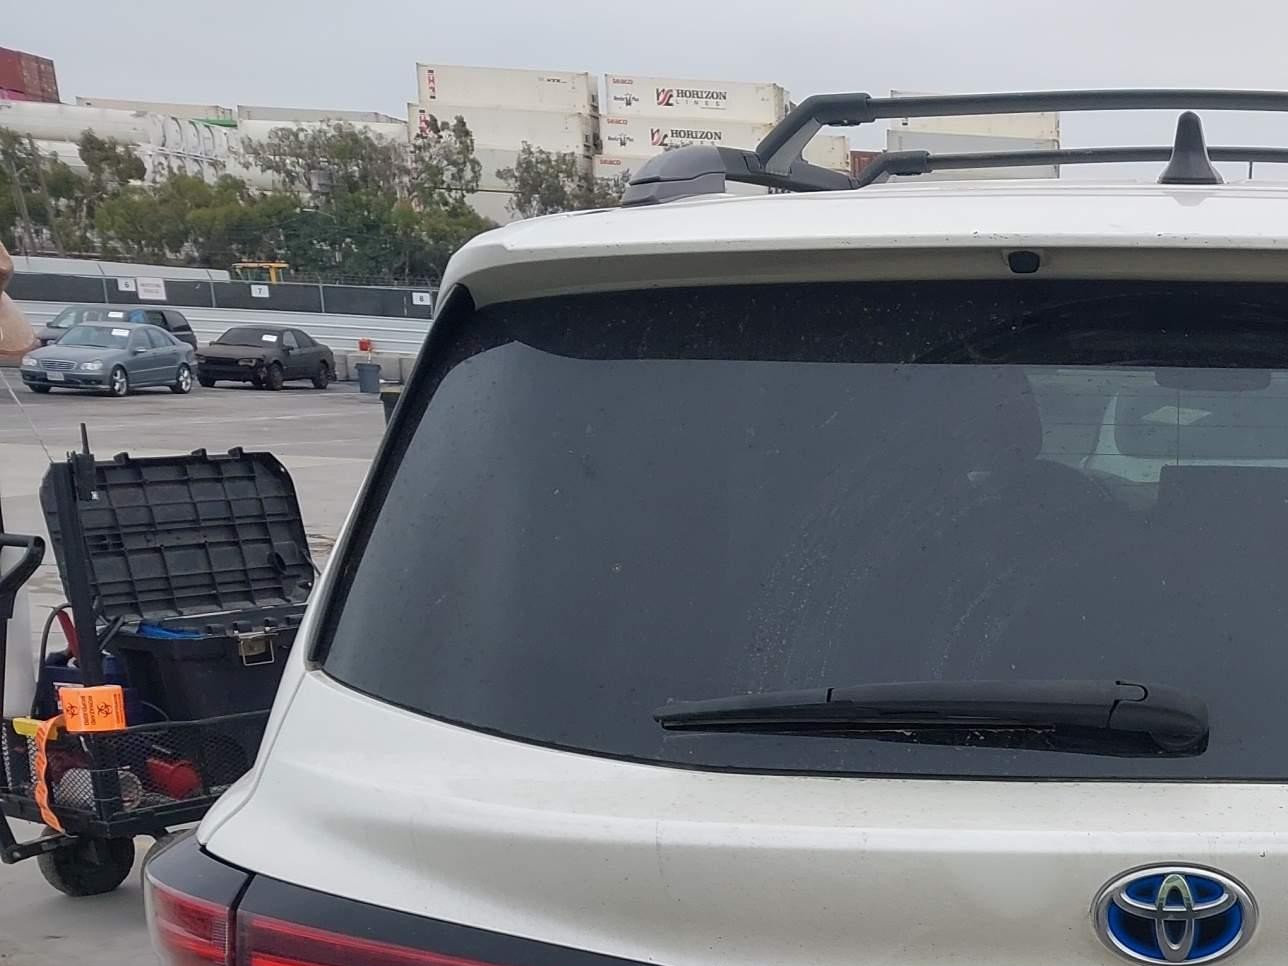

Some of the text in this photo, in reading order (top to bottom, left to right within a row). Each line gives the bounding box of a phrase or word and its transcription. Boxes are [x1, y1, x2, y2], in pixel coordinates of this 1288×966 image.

[676, 88, 728, 101] HORIZON
[675, 99, 721, 107] LINES
[670, 129, 722, 141] HORIZON
